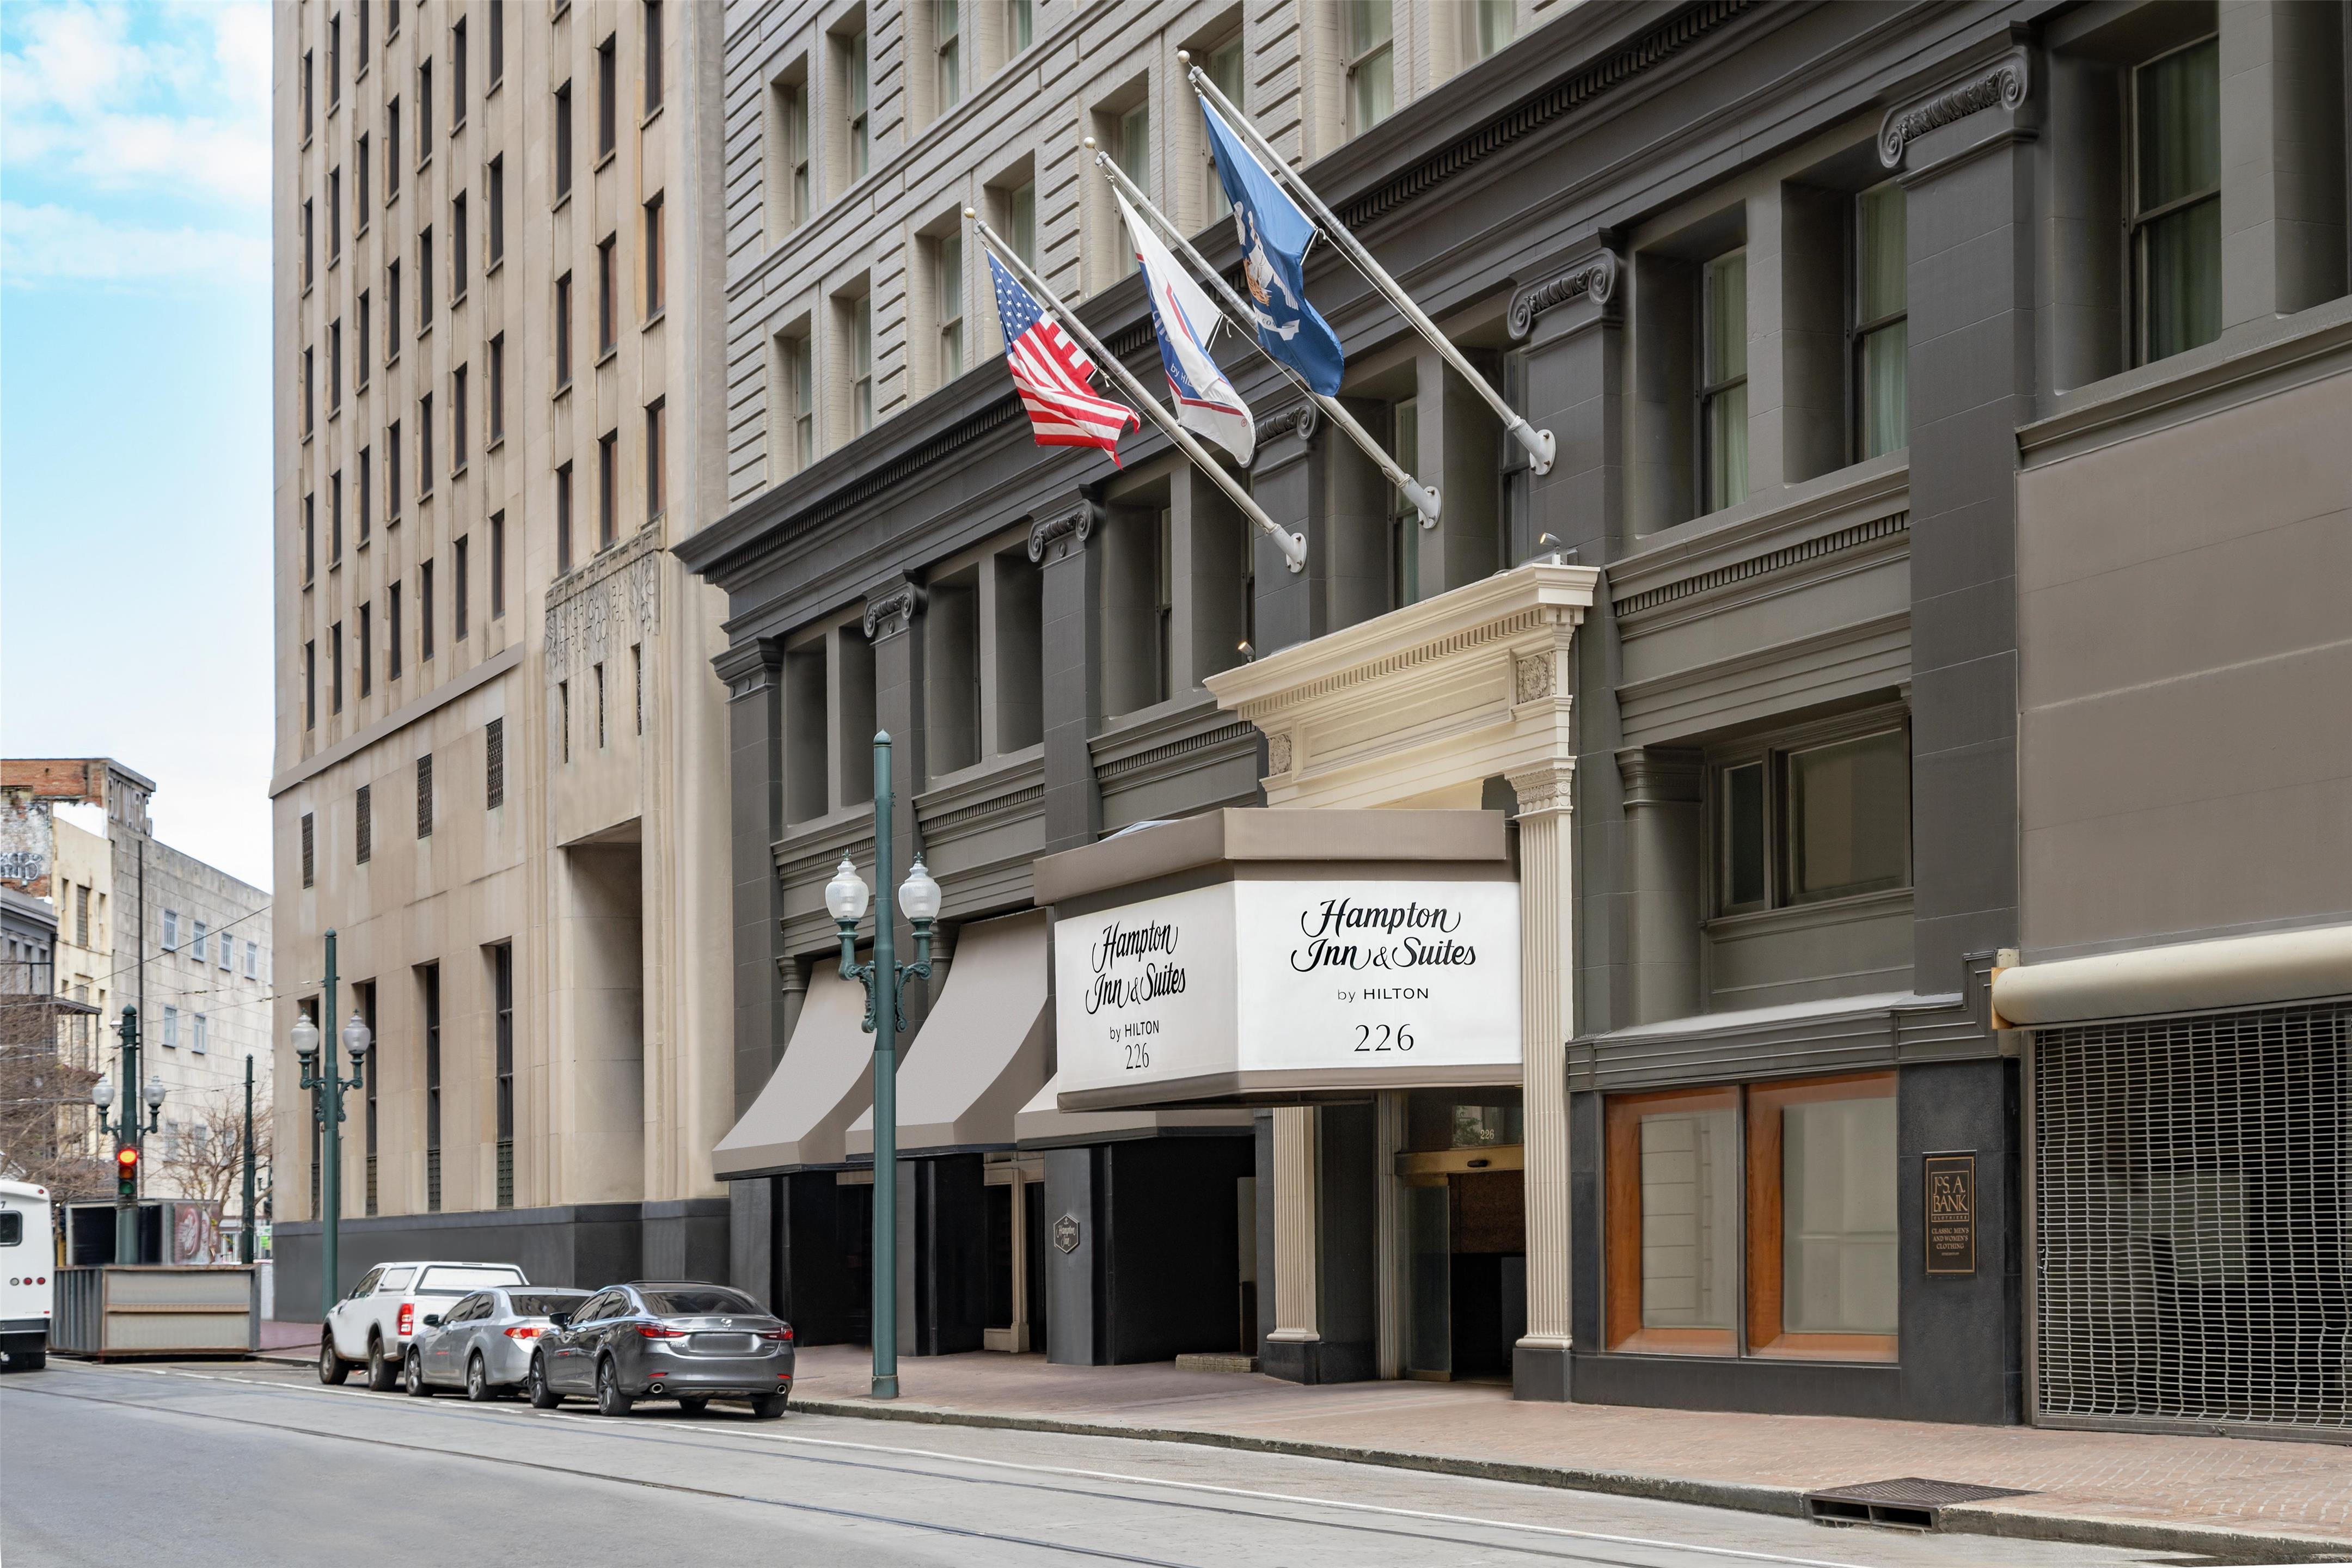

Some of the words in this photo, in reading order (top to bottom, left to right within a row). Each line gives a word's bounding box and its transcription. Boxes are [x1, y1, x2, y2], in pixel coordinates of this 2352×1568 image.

[1171, 363, 1180, 377] by
[1301, 897, 1461, 938] Hampton
[1092, 920, 1178, 973] Hampton
[1291, 938, 1371, 972] Inn
[1373, 946, 1393, 970] &
[1392, 936, 1476, 967] Suites
[1086, 972, 1130, 1014] Inn
[1130, 977, 1141, 1004] &
[1140, 961, 1186, 1001] Suites
[1338, 989, 1356, 1003] by
[1364, 988, 1429, 1000] HILTON
[1110, 1026, 1120, 1042] by
[1125, 1020, 1159, 1037] HILTON
[1353, 1024, 1414, 1052] 226
[1125, 1043, 1149, 1069] 226
[1480, 1129, 1494, 1140] 226
[1953, 1175, 1965, 1193] A.
[1933, 1195, 1968, 1212] BANK
[1056, 1225, 1076, 1238] Hampton
[1061, 1235, 1071, 1247] Inn
